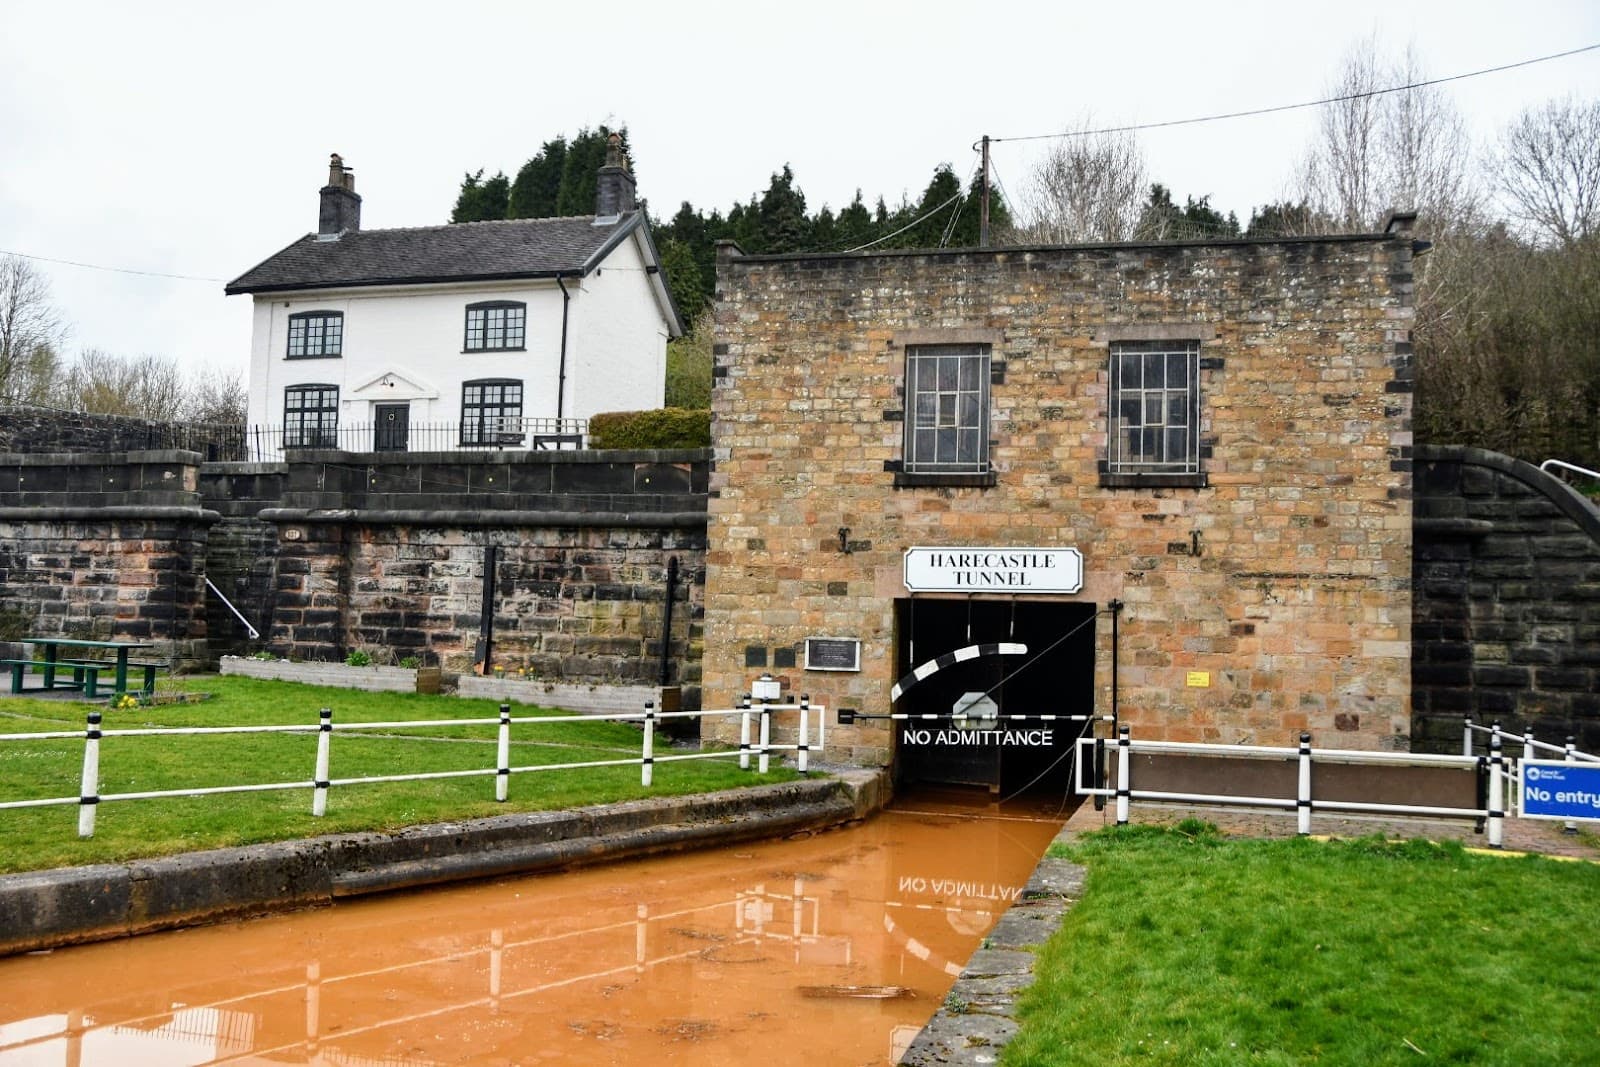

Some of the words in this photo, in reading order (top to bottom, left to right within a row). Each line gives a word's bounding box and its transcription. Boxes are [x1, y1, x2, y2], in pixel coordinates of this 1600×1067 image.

[930, 553, 1056, 568] HARECASTLE
[952, 571, 1032, 586] TUNNEL
[903, 730, 931, 745] NO
[935, 730, 1053, 746] ADMITTANCE
[1526, 786, 1551, 802] No
[1555, 790, 1600, 808] entry
